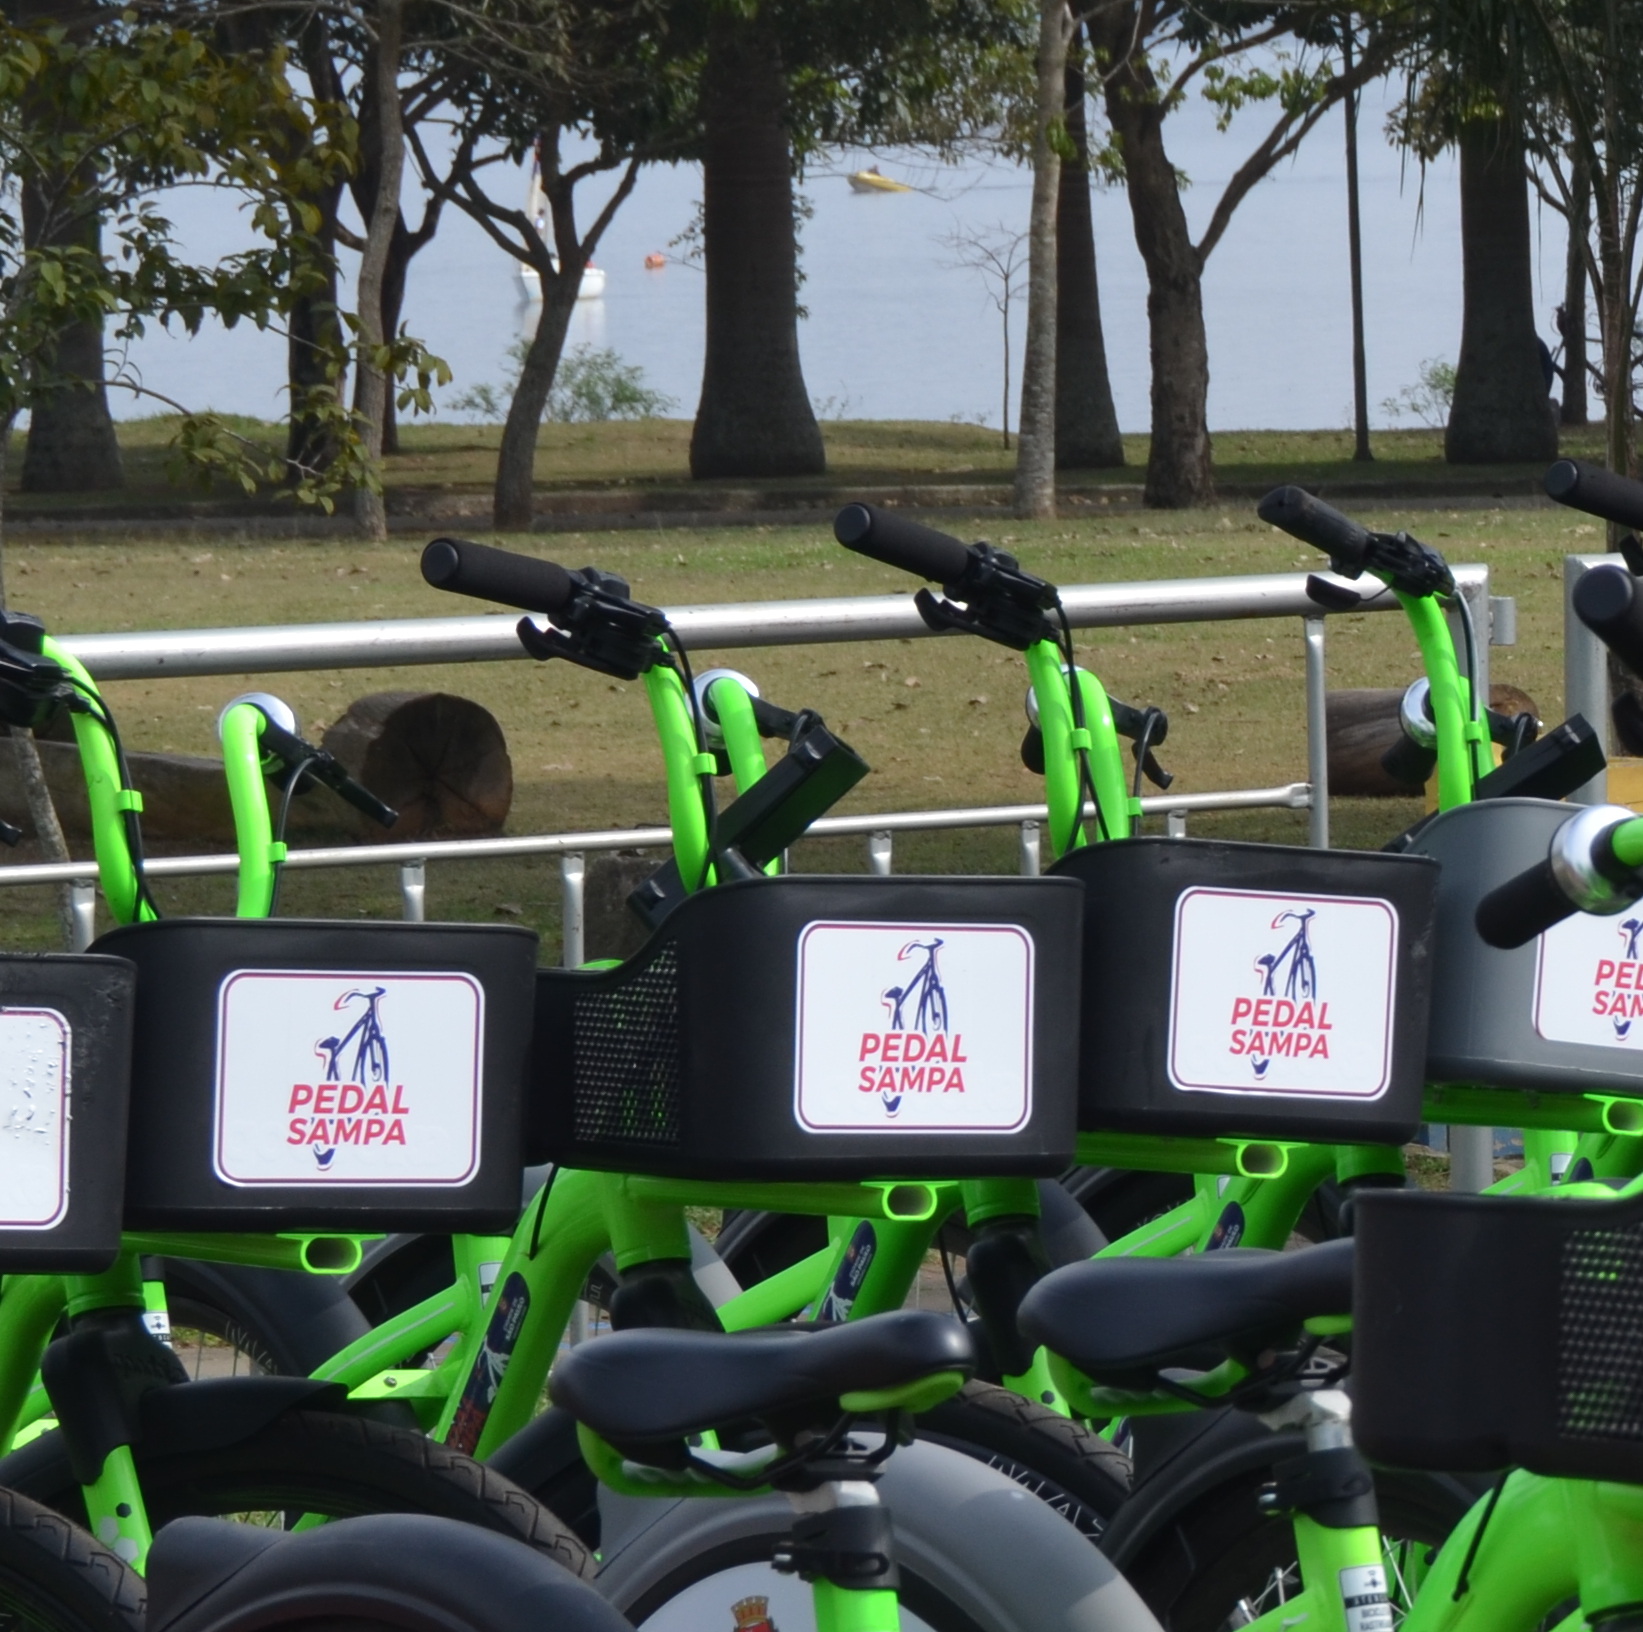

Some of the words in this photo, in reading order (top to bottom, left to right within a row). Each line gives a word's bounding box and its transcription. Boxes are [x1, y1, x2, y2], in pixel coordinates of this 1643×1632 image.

[1231, 997, 1333, 1031] PEDAL
[858, 1032, 968, 1063] PEDAL
[1229, 1029, 1330, 1059] SAMPA
[858, 1065, 966, 1093] SAMPA
[288, 1083, 410, 1115] PEDAL
[287, 1117, 406, 1146] SAMPA
